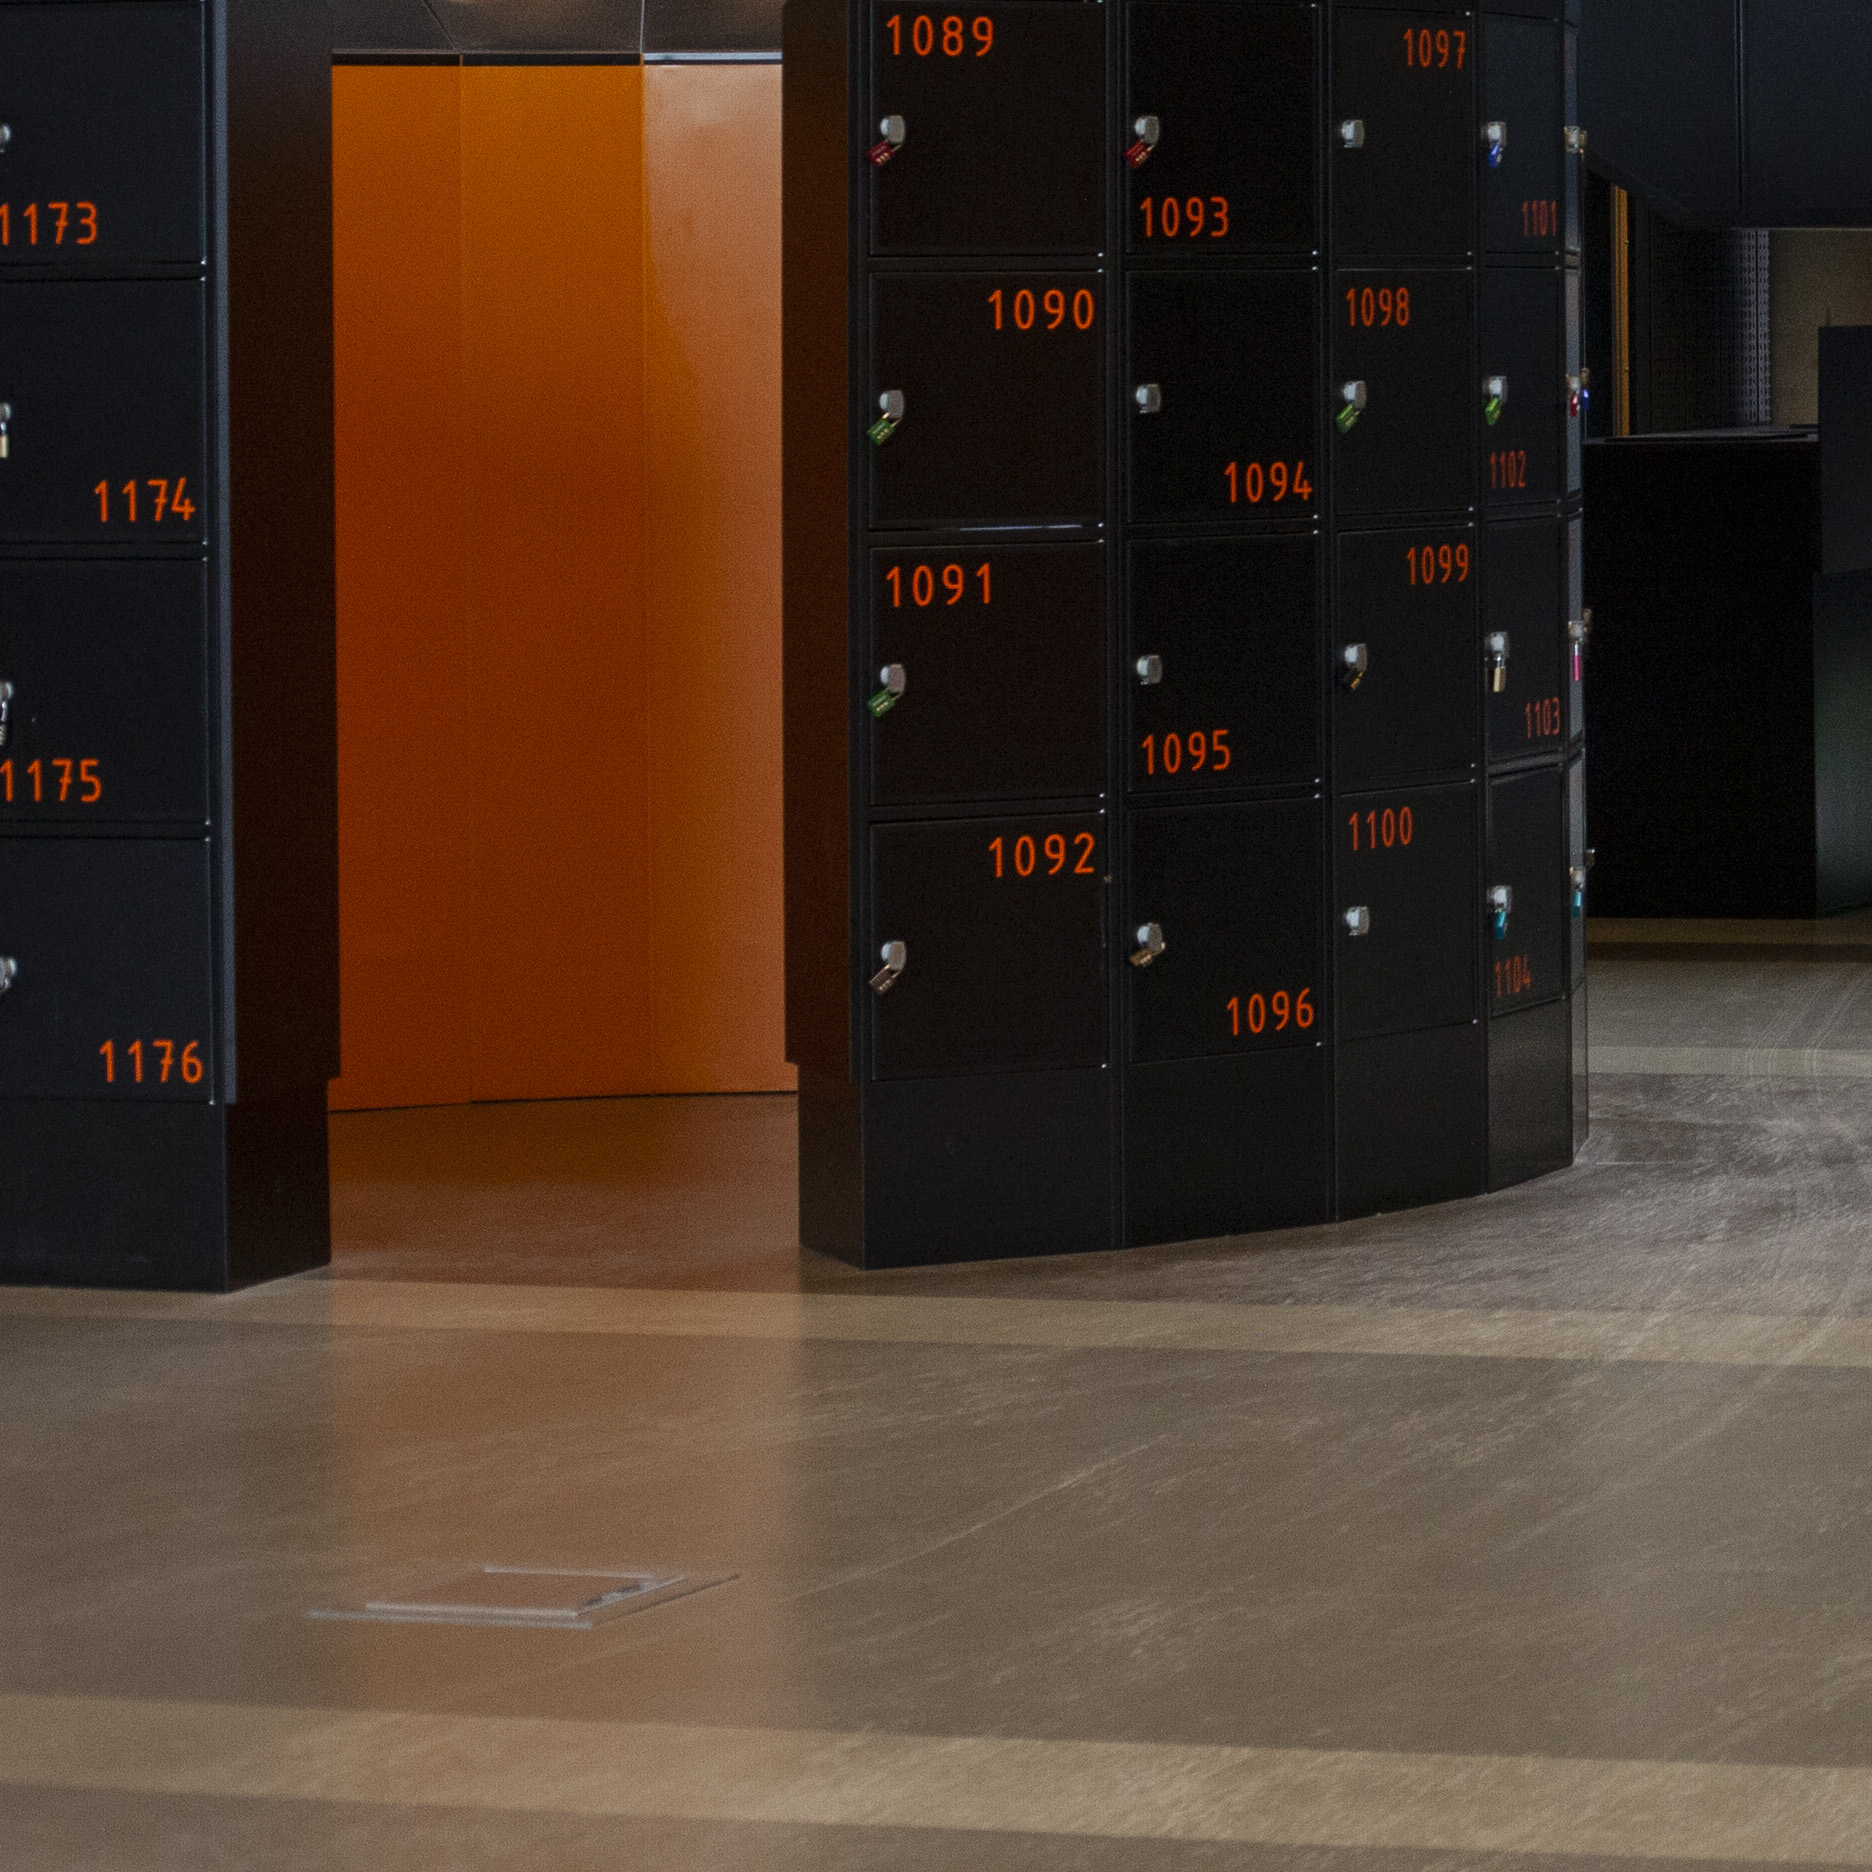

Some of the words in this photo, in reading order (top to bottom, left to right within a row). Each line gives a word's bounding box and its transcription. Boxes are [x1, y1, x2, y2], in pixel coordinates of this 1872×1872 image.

[886, 14, 994, 57] 1089
[1403, 28, 1467, 69] 1097
[0, 201, 97, 244] 1173
[1140, 195, 1229, 238] 1093
[1521, 199, 1557, 237] 1101
[987, 288, 1095, 331] 1090
[1345, 286, 1410, 327] 1098
[1224, 461, 1313, 503] 1094
[1488, 449, 1527, 489] 1102
[93, 476, 196, 523] 1174
[885, 562, 991, 608] 1091
[1406, 543, 1470, 585] 1099
[1524, 696, 1561, 739] 1103
[1142, 728, 1231, 775] 1095
[0, 759, 101, 802] 1175
[1348, 806, 1413, 851] 1100
[988, 831, 1095, 878] 1092
[1494, 955, 1533, 997] 1104
[1226, 987, 1314, 1036] 1096
[99, 1039, 204, 1084] 1176
